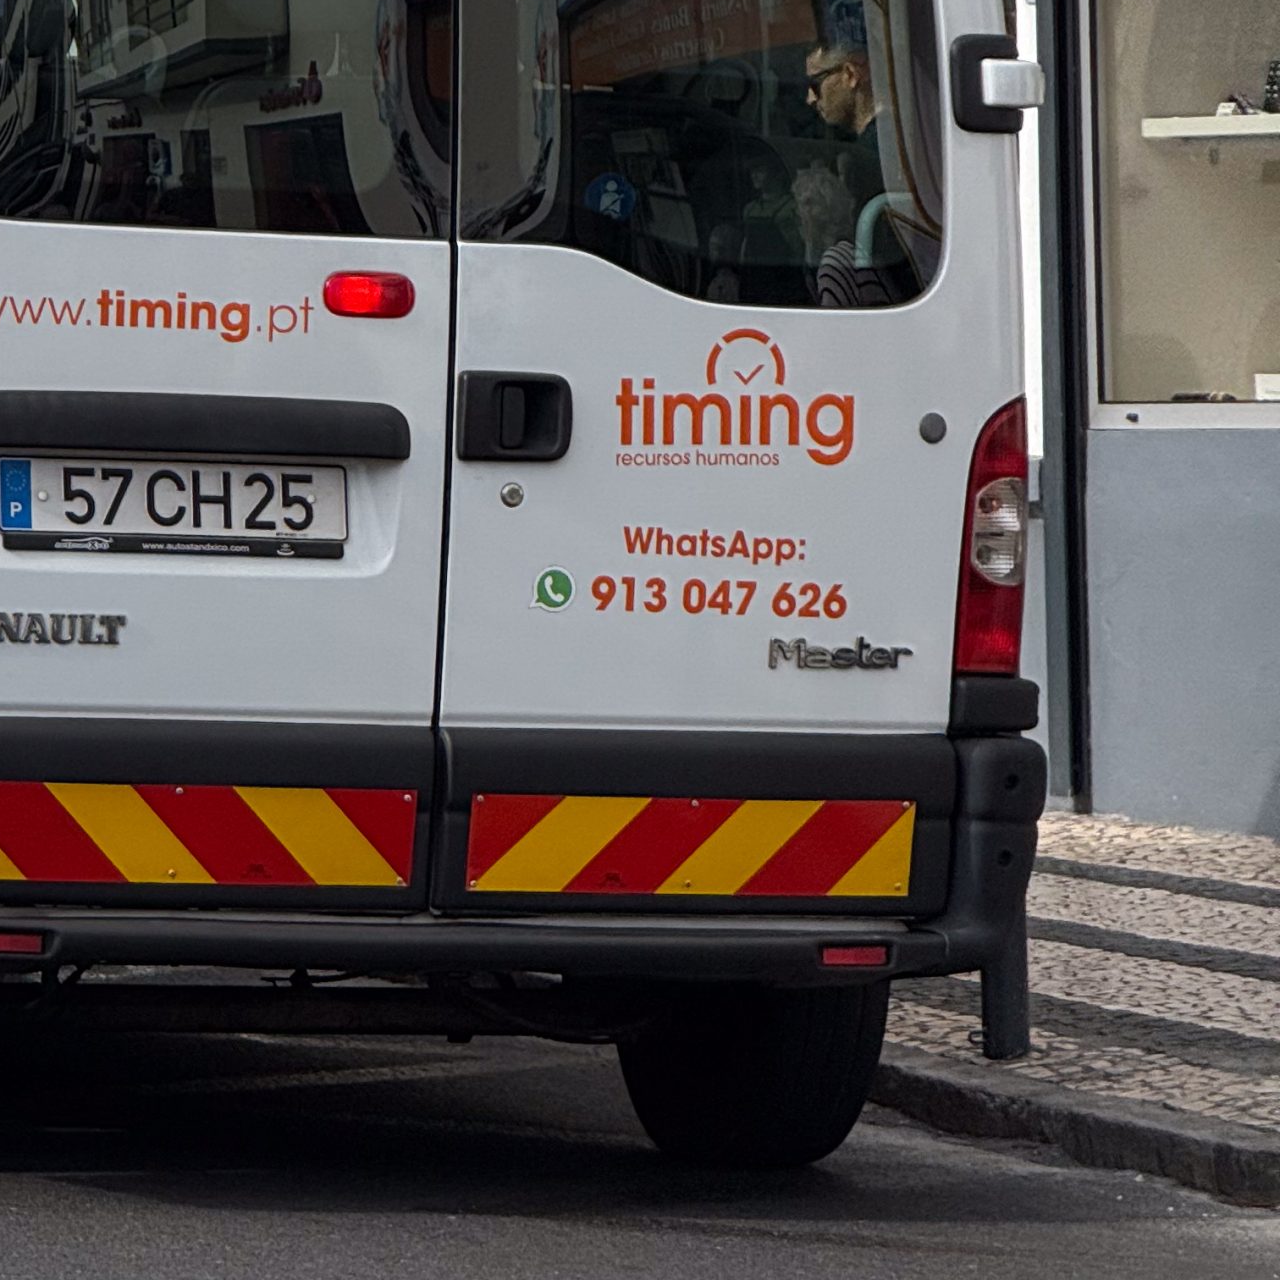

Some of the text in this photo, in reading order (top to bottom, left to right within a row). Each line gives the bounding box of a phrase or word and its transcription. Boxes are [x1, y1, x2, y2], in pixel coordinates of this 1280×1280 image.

[616, 378, 855, 466] timing
[616, 450, 780, 466] recursos humanos
[9, 501, 23, 518] P
[623, 526, 807, 565] WhatsApp:
[591, 575, 848, 619] 913 047 626
[767, 635, 913, 671] Master
